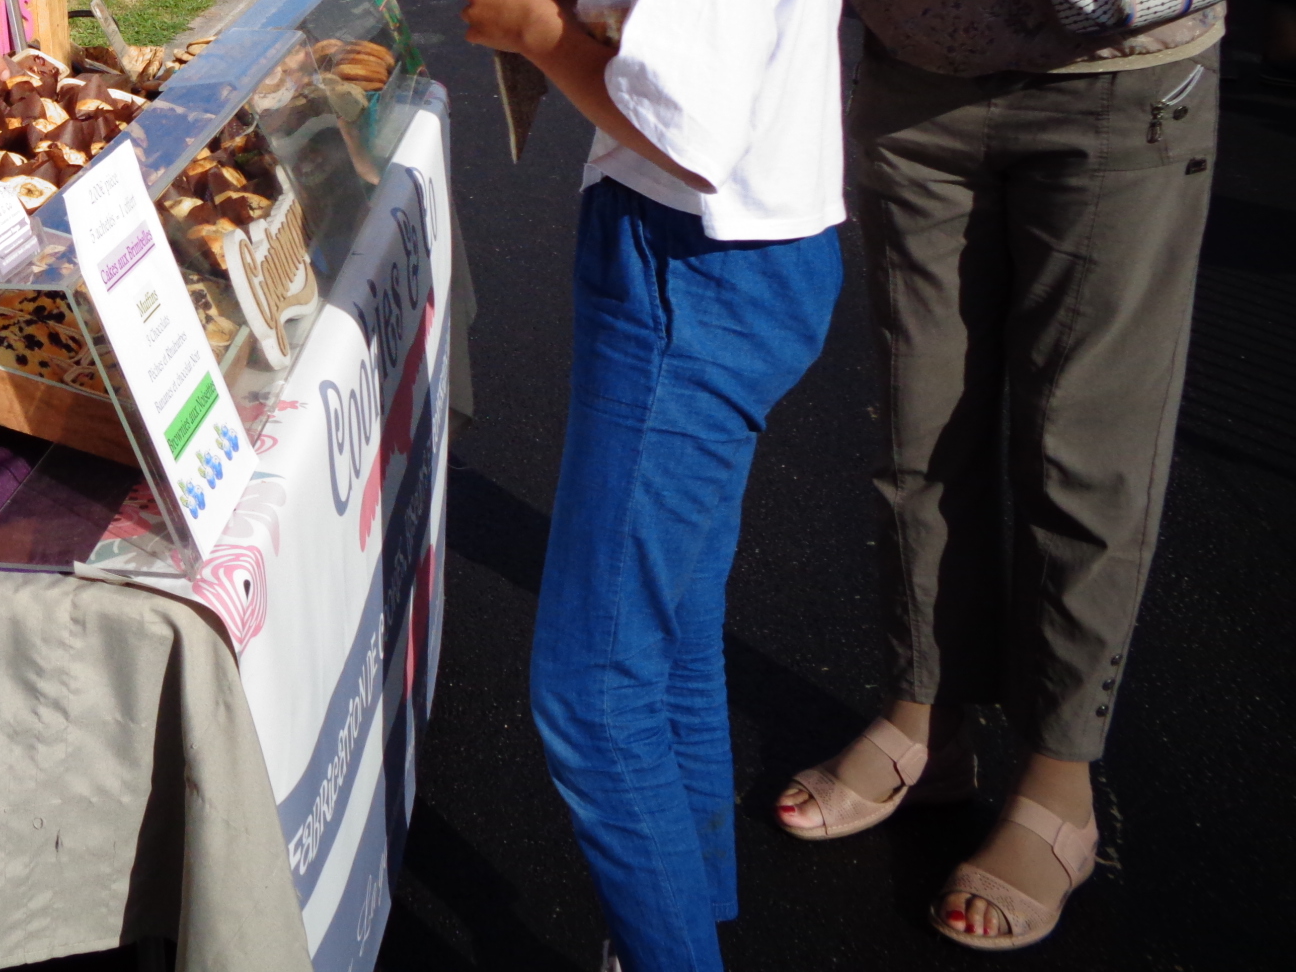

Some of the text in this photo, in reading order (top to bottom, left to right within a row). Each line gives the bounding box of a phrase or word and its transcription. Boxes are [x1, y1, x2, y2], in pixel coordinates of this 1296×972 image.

[100, 228, 154, 285] Cakes aux Brimbelles
[136, 289, 160, 318] Muffins
[154, 383, 175, 414] Bananes
[190, 349, 201, 372] Noir
[318, 262, 404, 517] Cookies
[390, 206, 420, 311] &
[166, 379, 217, 455] Brownies aux Noisettes
